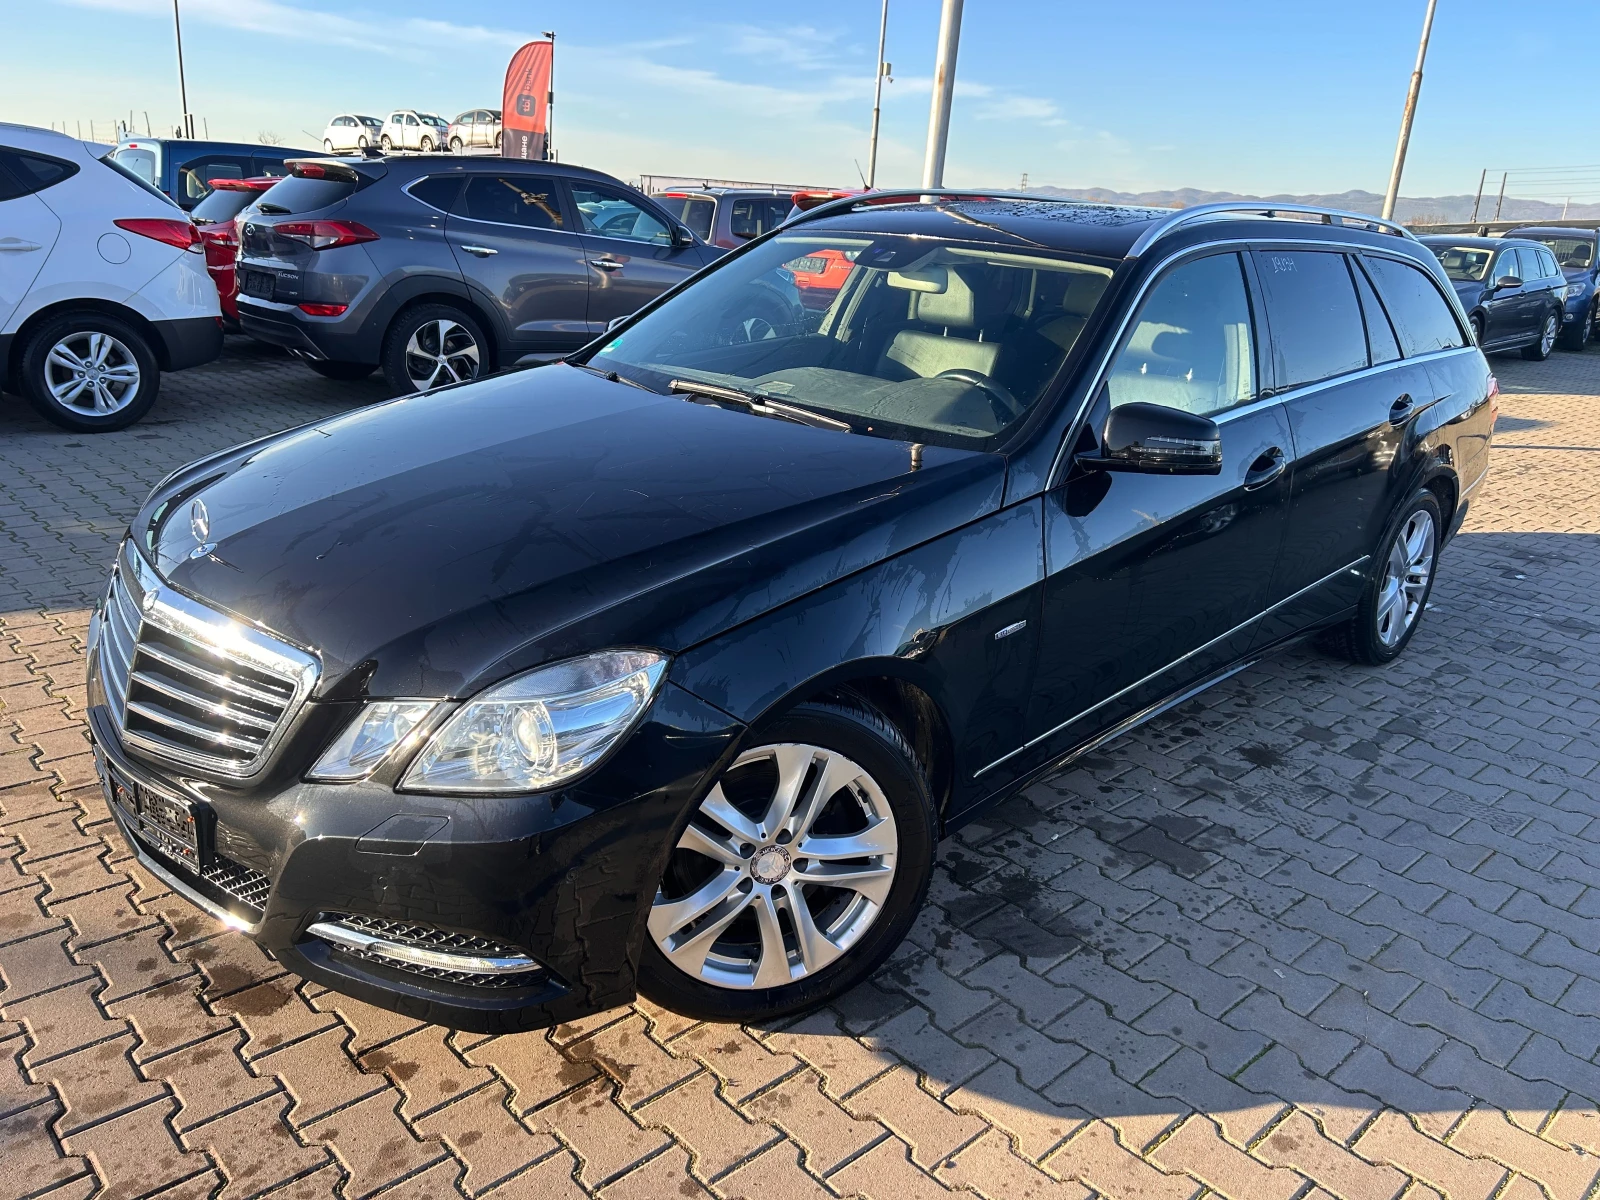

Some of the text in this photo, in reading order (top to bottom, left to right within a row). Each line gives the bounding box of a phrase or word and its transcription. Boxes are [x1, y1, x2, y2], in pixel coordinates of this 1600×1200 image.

[522, 67, 532, 112] tbi bank
[277, 270, 300, 280] TUCSON
